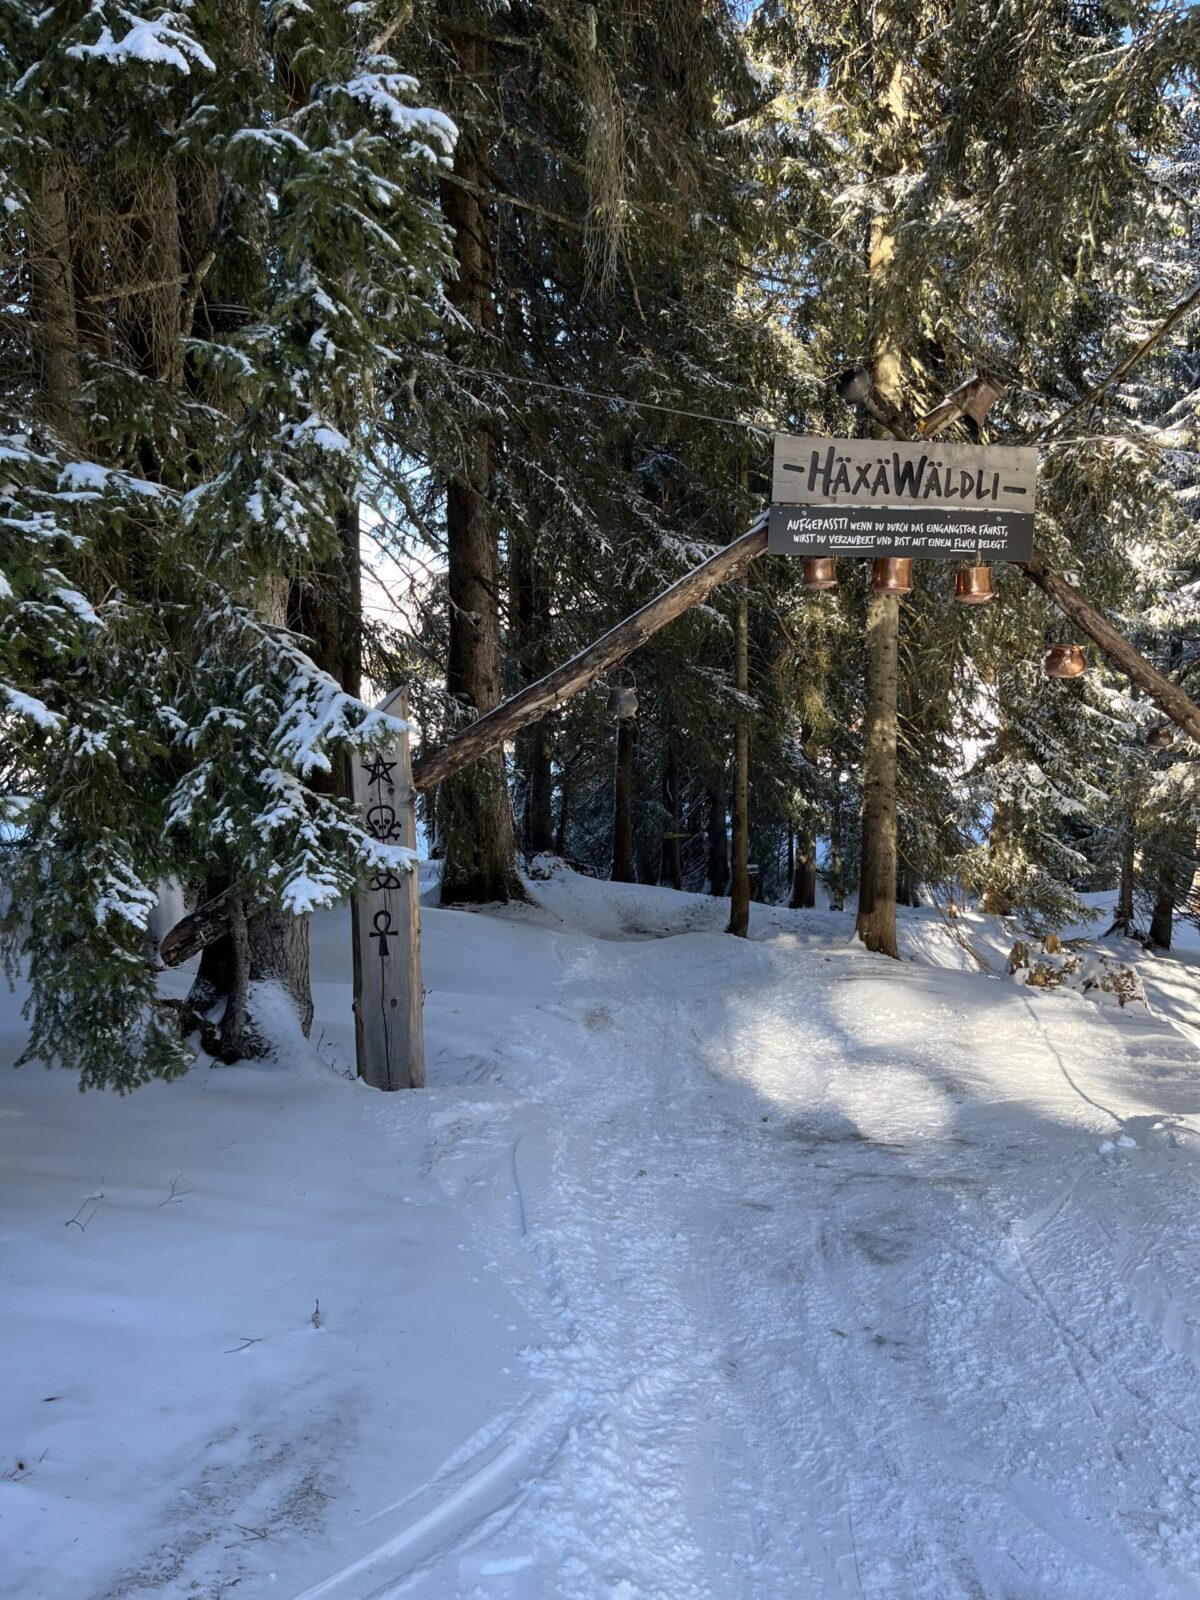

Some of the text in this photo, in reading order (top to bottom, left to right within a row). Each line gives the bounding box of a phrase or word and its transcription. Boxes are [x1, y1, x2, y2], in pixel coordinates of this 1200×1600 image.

[787, 517, 1008, 537] AUFGEPASST! WENN DU DURCH DAS EINGANGSTOR FÄHRST,
[793, 534, 1008, 549] WIRST DU VERZAUBERT UND BIST MIT EINEM FLUCH BELEGT.
